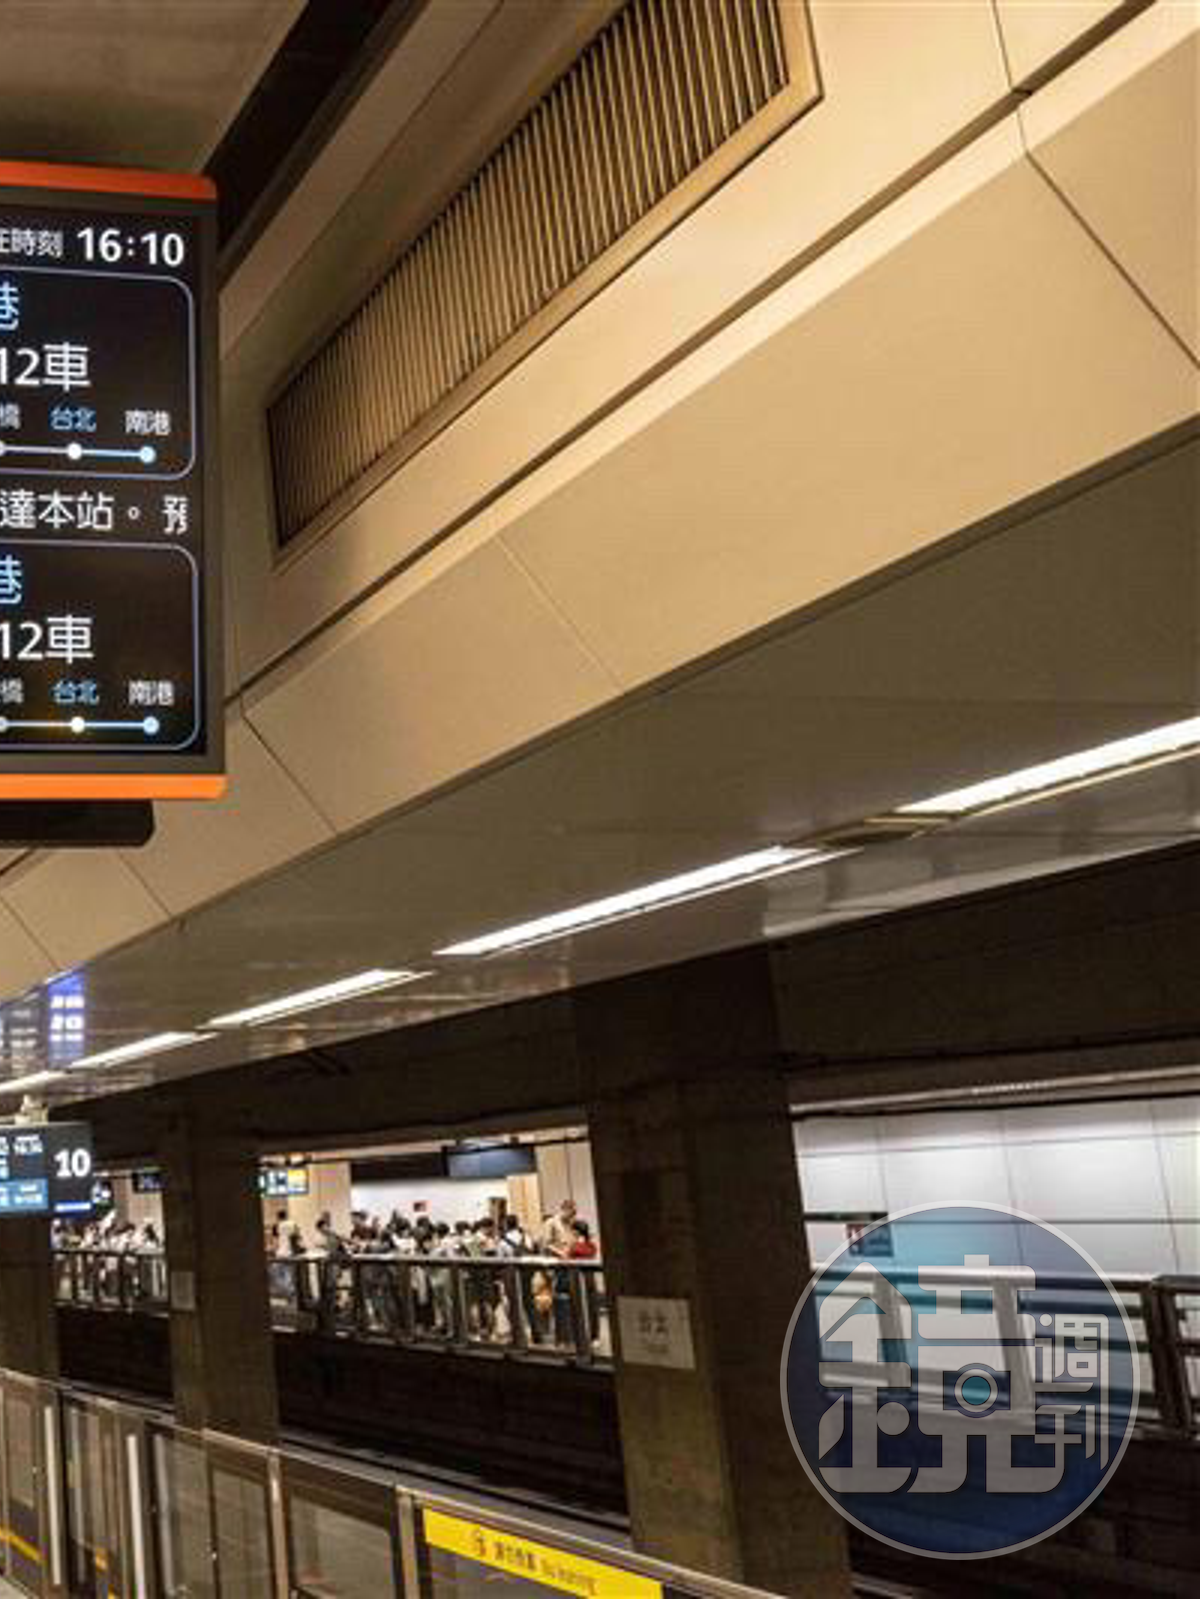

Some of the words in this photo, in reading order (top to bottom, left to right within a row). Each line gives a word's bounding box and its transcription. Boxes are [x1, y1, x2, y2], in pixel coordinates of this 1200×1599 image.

[78, 228, 184, 266] 16:10
[51, 407, 96, 432] 台北
[126, 410, 170, 435] 南港
[53, 680, 99, 704] 台北
[130, 681, 173, 705] 南港
[55, 1149, 90, 1177] 10
